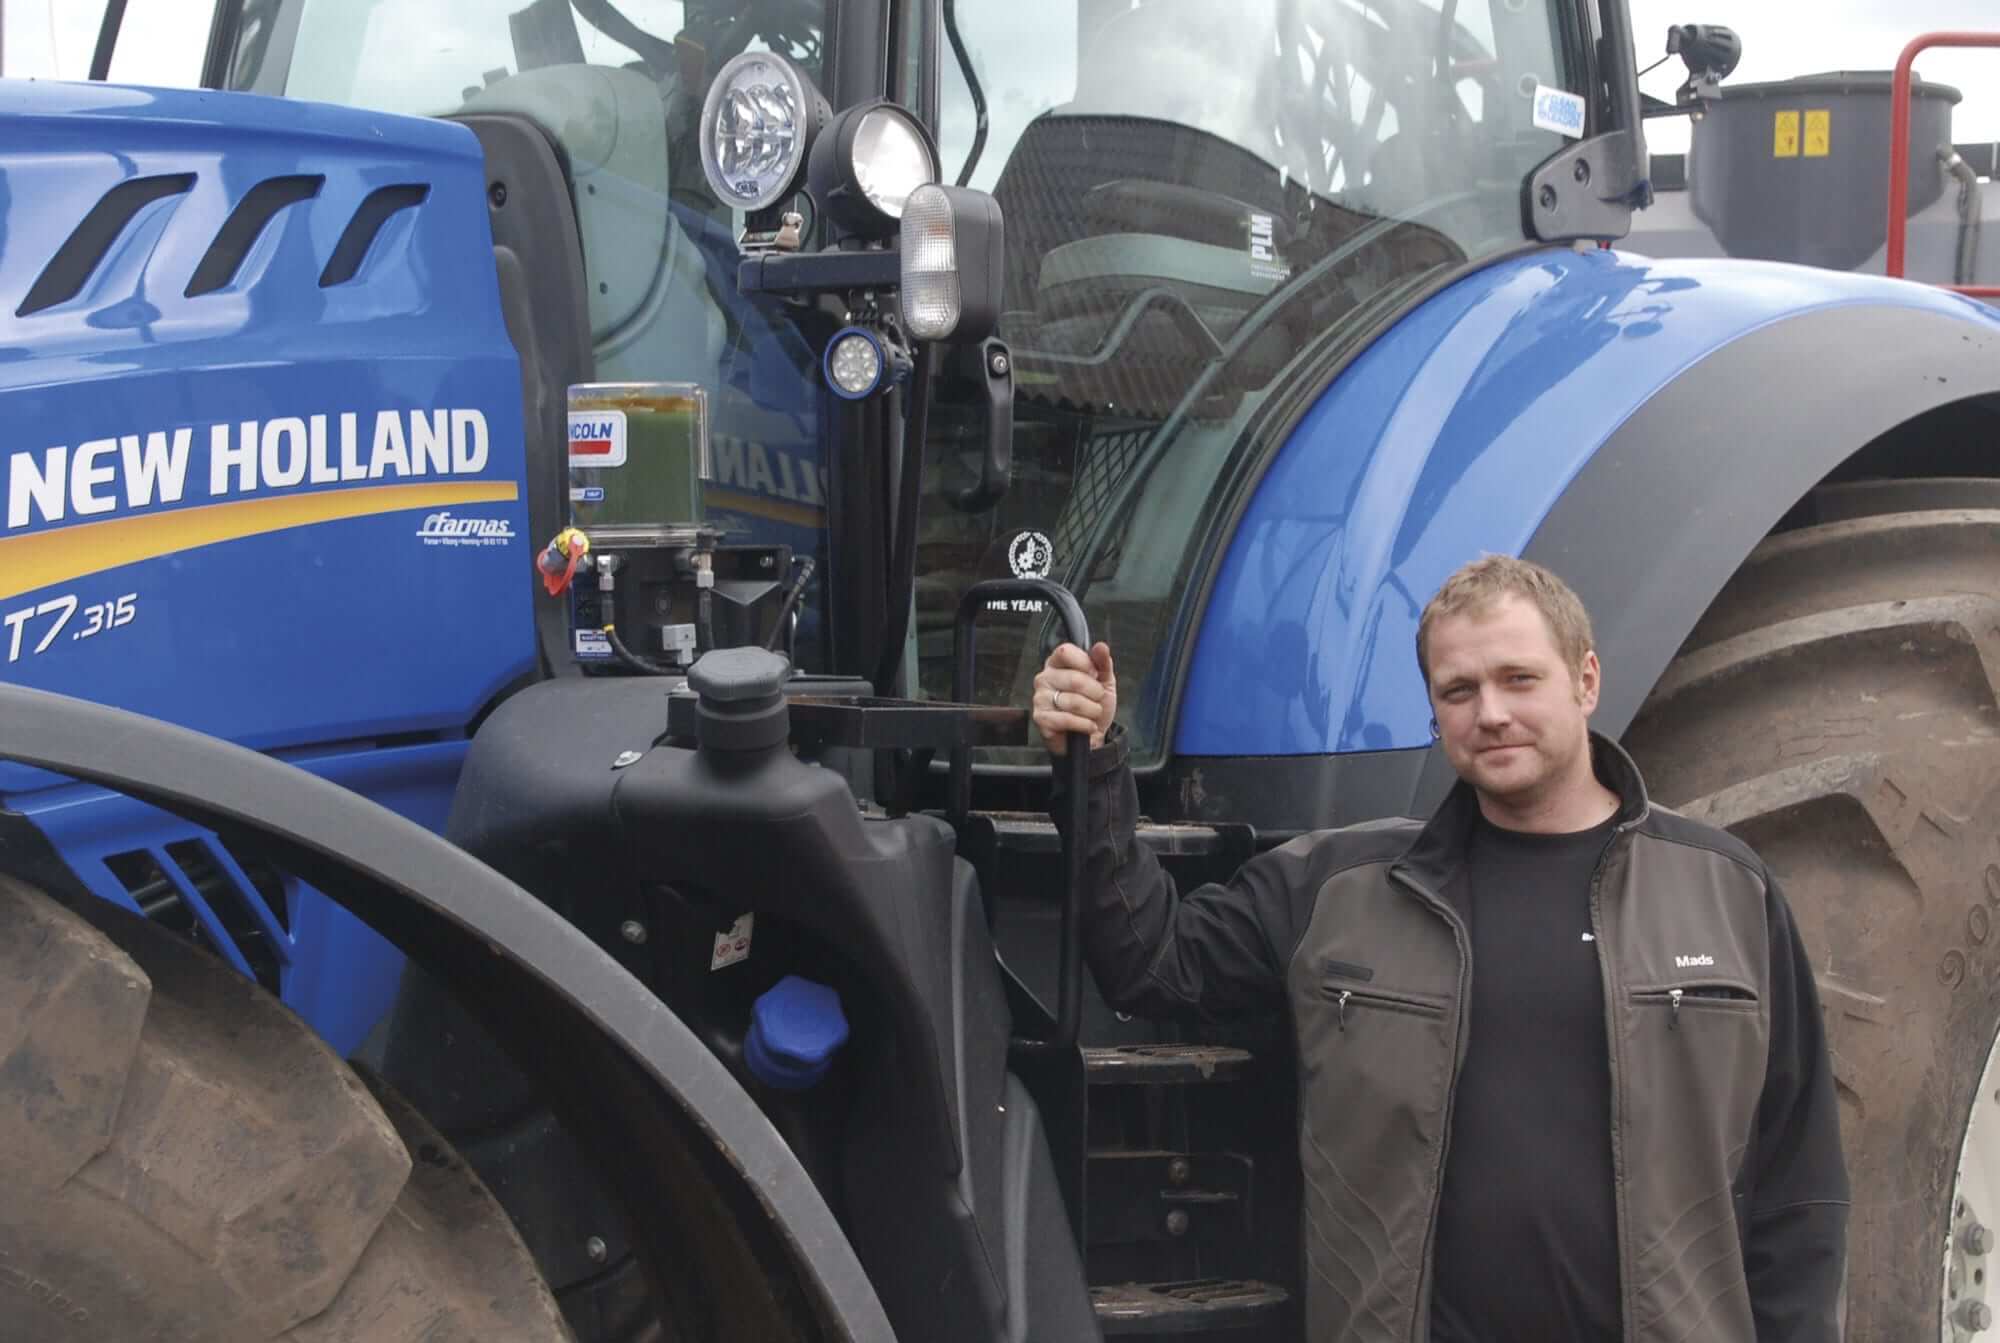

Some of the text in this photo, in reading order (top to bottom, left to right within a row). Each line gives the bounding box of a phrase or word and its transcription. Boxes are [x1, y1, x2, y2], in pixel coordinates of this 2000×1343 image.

[1251, 213, 1272, 261] PLM
[8, 408, 489, 528] NEW HOLLAND
[1011, 599, 1042, 612] YEAR
[1675, 954, 1714, 968] Mads
